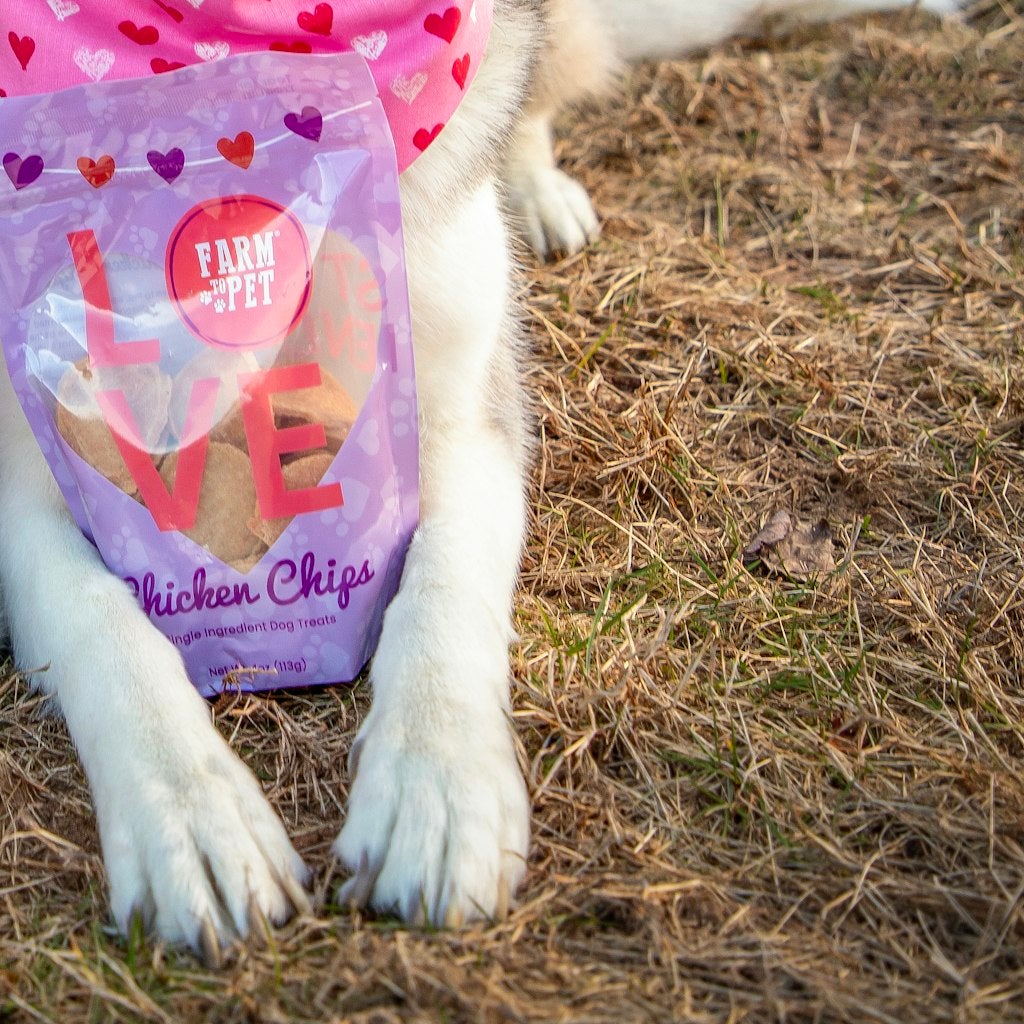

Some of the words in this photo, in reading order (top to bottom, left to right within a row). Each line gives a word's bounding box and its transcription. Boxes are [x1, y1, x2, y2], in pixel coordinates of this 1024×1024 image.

[209, 277, 226, 295] TO
[225, 269, 275, 311] PET
[266, 551, 375, 610] Chips
[168, 630, 201, 646] ingle
[204, 621, 267, 638] Ingredient
[270, 620, 295, 633] Dog
[297, 613, 337, 627] Treats
